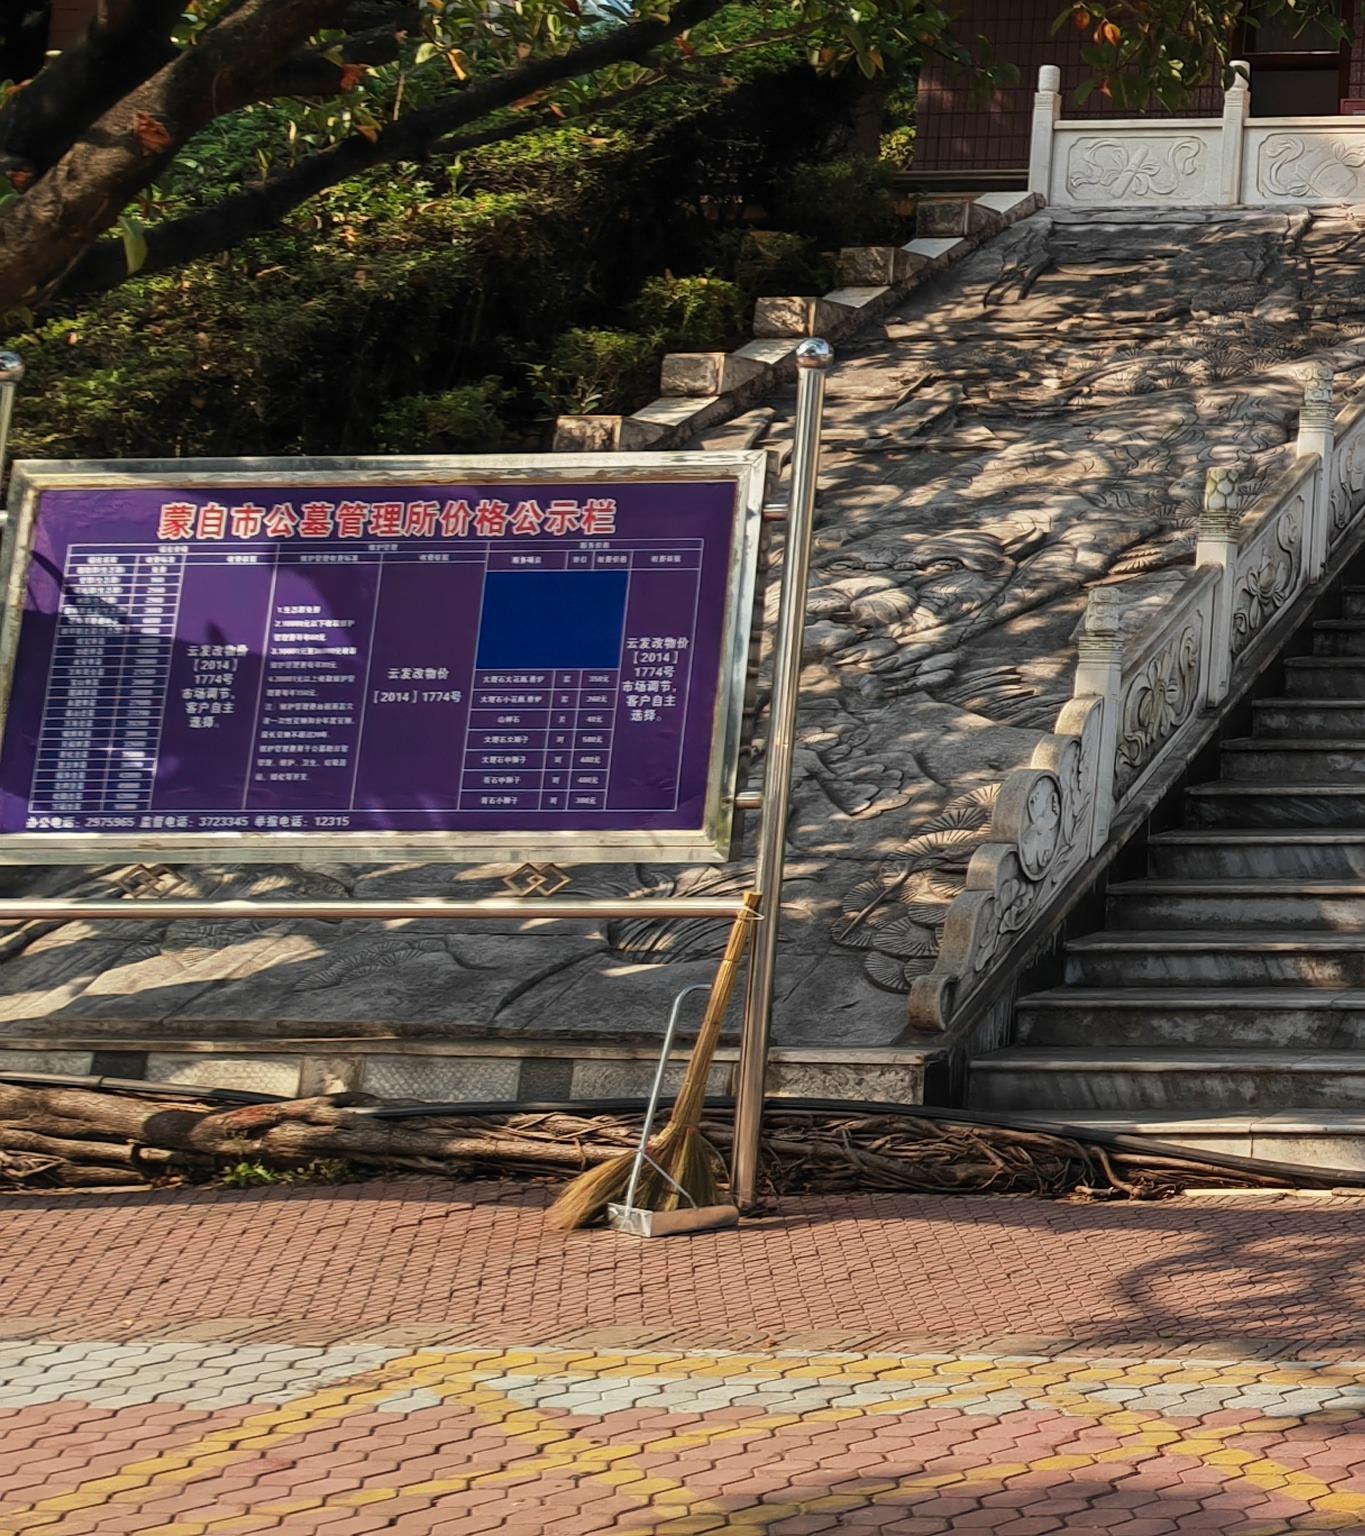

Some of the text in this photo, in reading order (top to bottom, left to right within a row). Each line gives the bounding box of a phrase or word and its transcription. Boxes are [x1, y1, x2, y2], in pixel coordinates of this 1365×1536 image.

[158, 500, 617, 540] 蒙自市公墓管理所价格公示栏
[634, 666, 675, 677] 1774号
[625, 695, 676, 707] 客户自主
